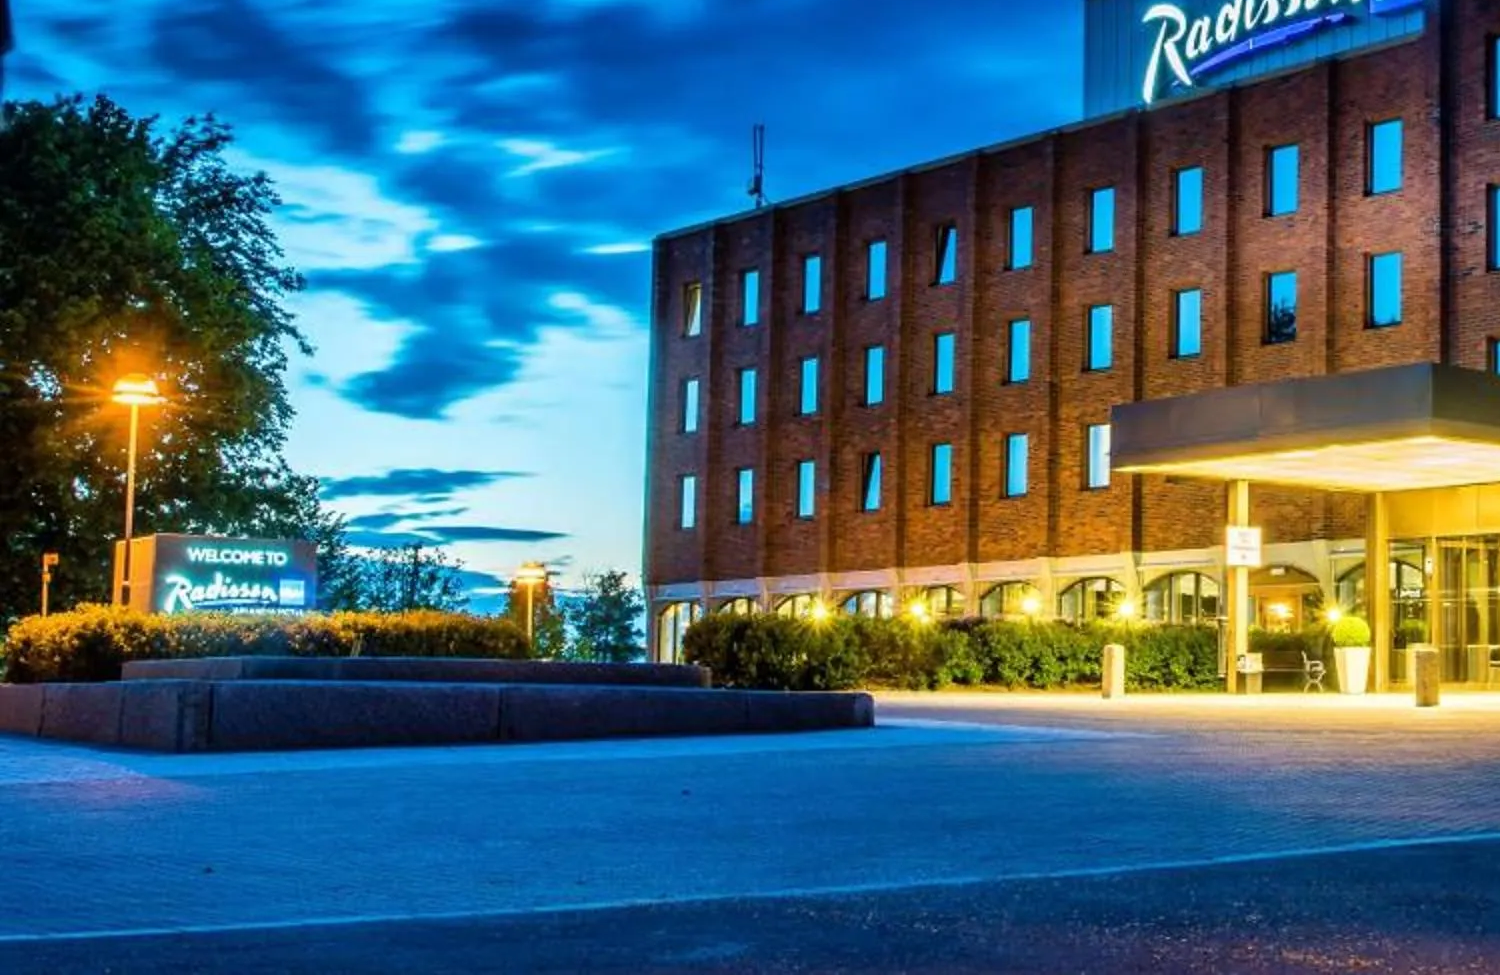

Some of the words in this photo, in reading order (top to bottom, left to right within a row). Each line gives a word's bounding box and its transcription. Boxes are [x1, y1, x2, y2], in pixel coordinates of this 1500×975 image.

[186, 546, 264, 565] WELCOME
[265, 550, 288, 566] TO
[164, 571, 279, 615] Radisson
